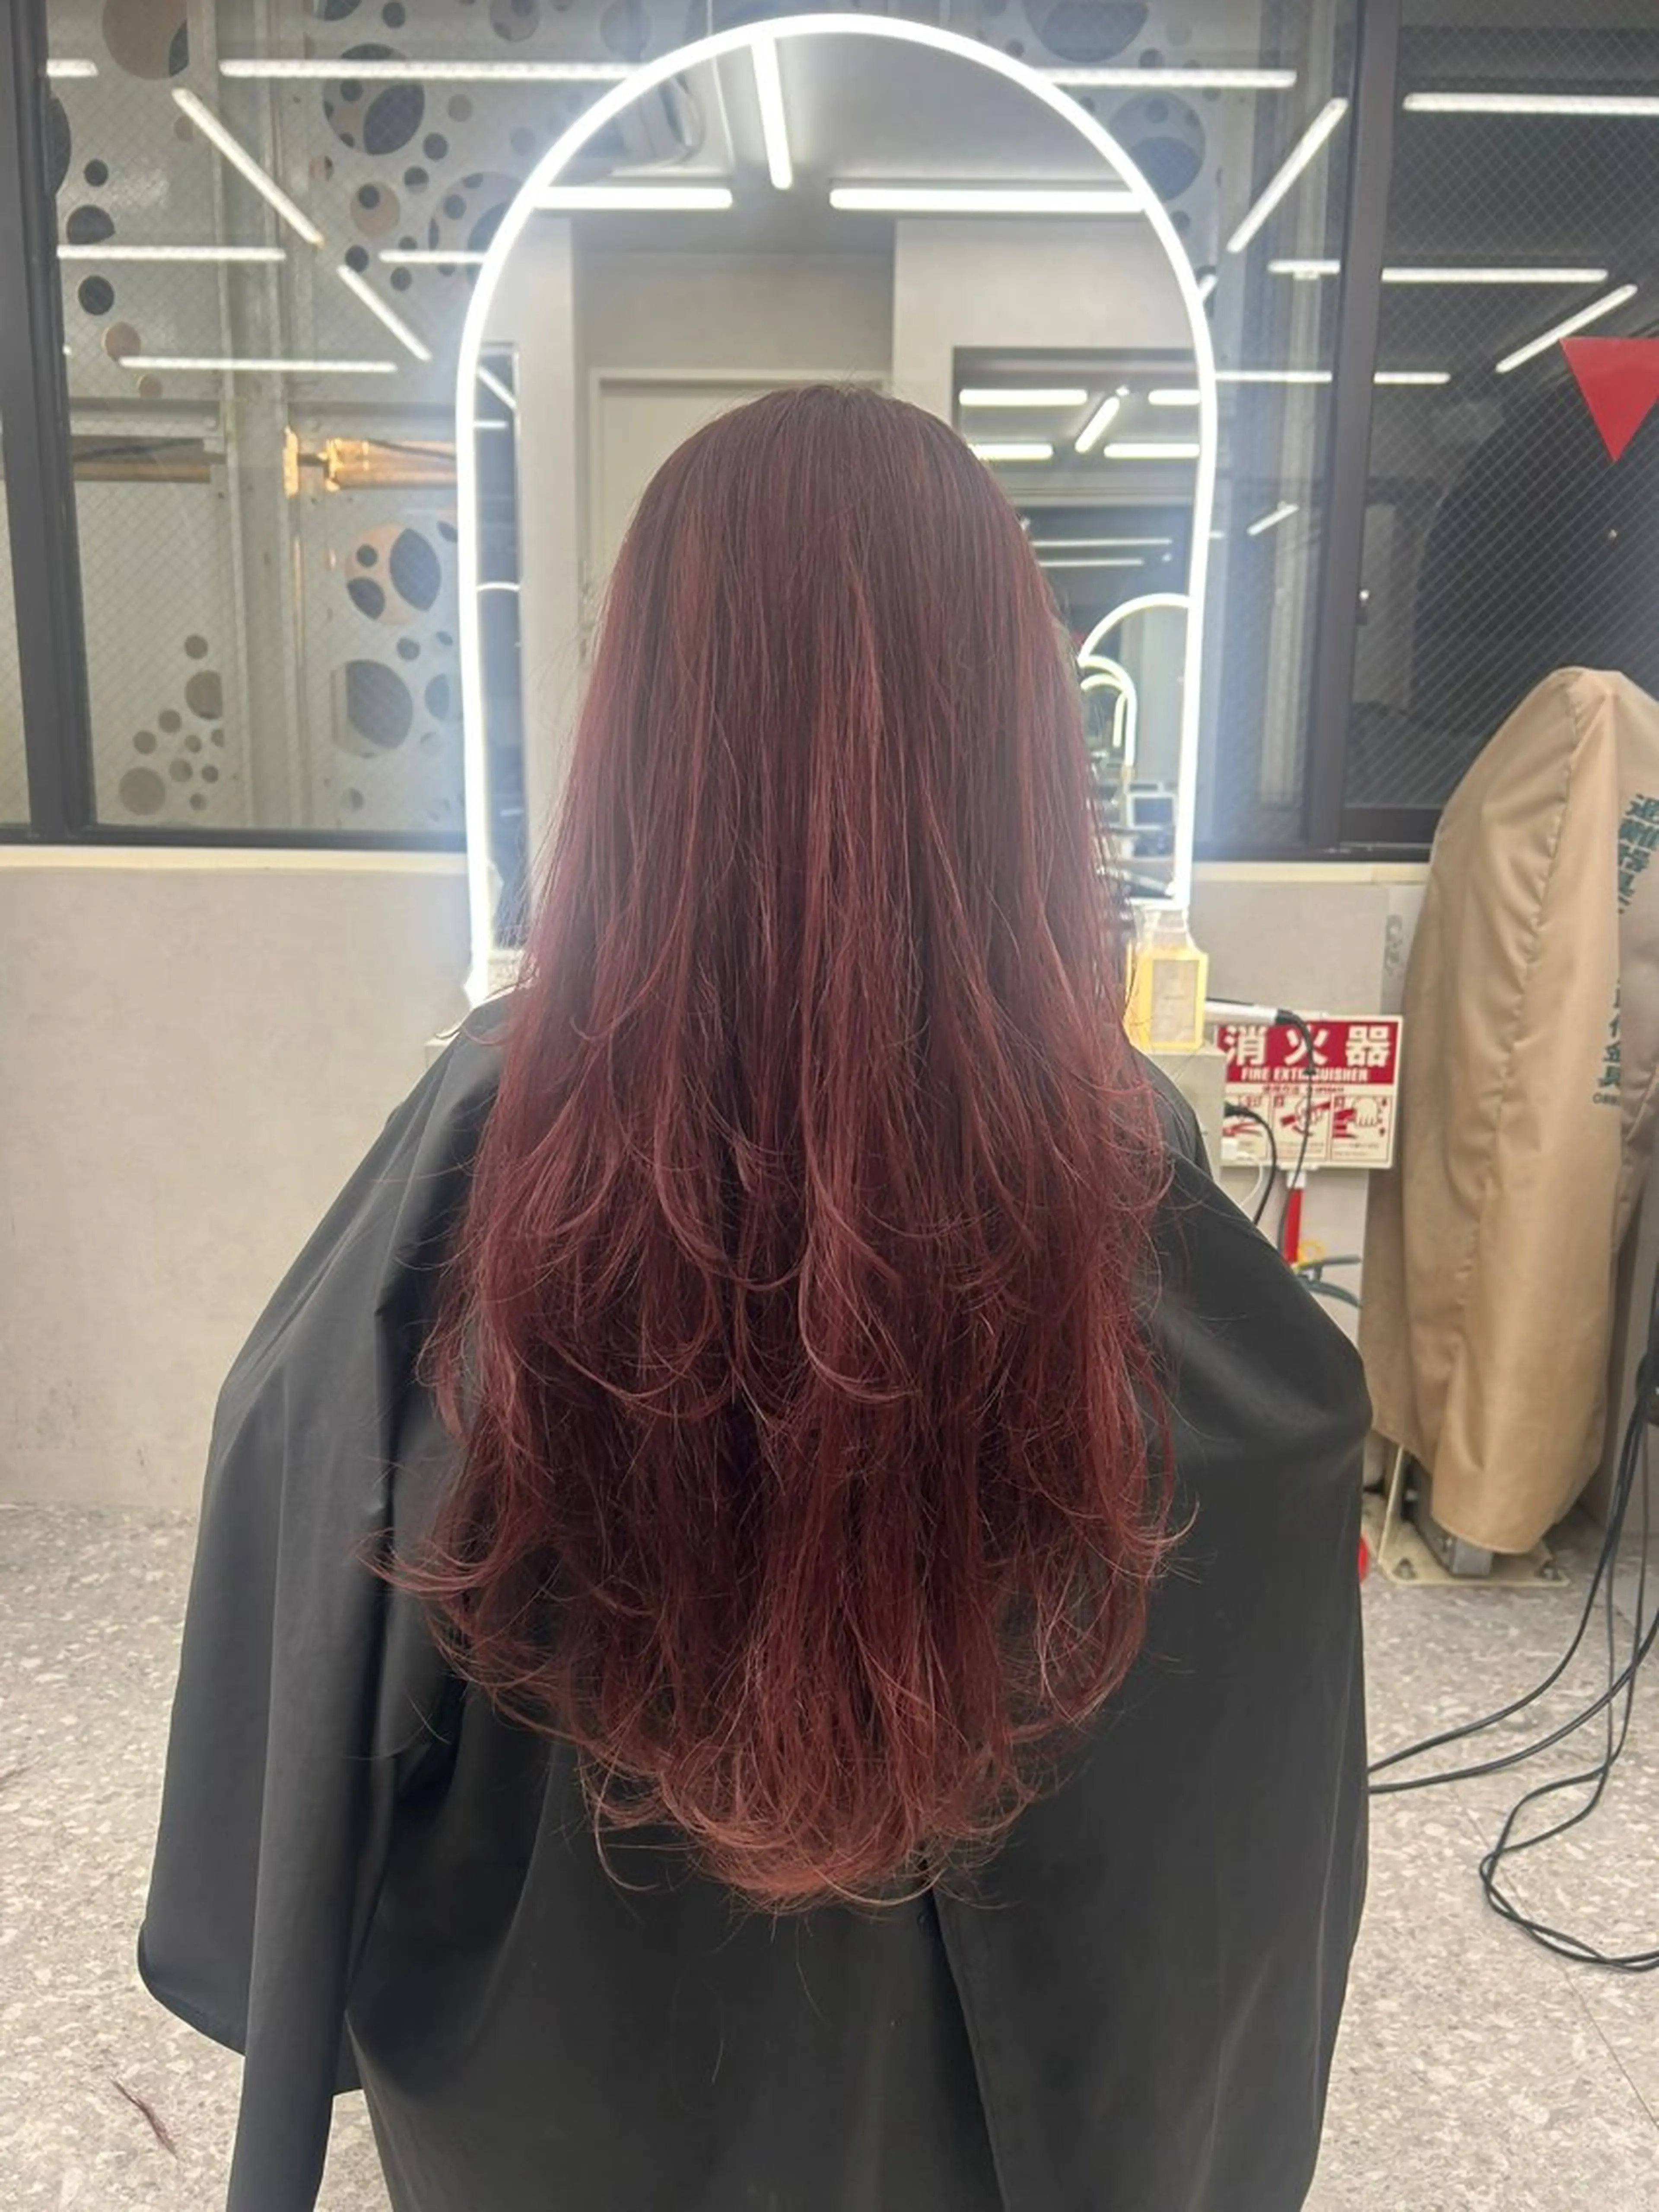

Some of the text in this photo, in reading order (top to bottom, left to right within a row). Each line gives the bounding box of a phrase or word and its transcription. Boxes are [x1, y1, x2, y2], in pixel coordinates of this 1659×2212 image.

[1224, 1025, 1390, 1067] 消火器
[1241, 1067, 1269, 1081] FIRE
